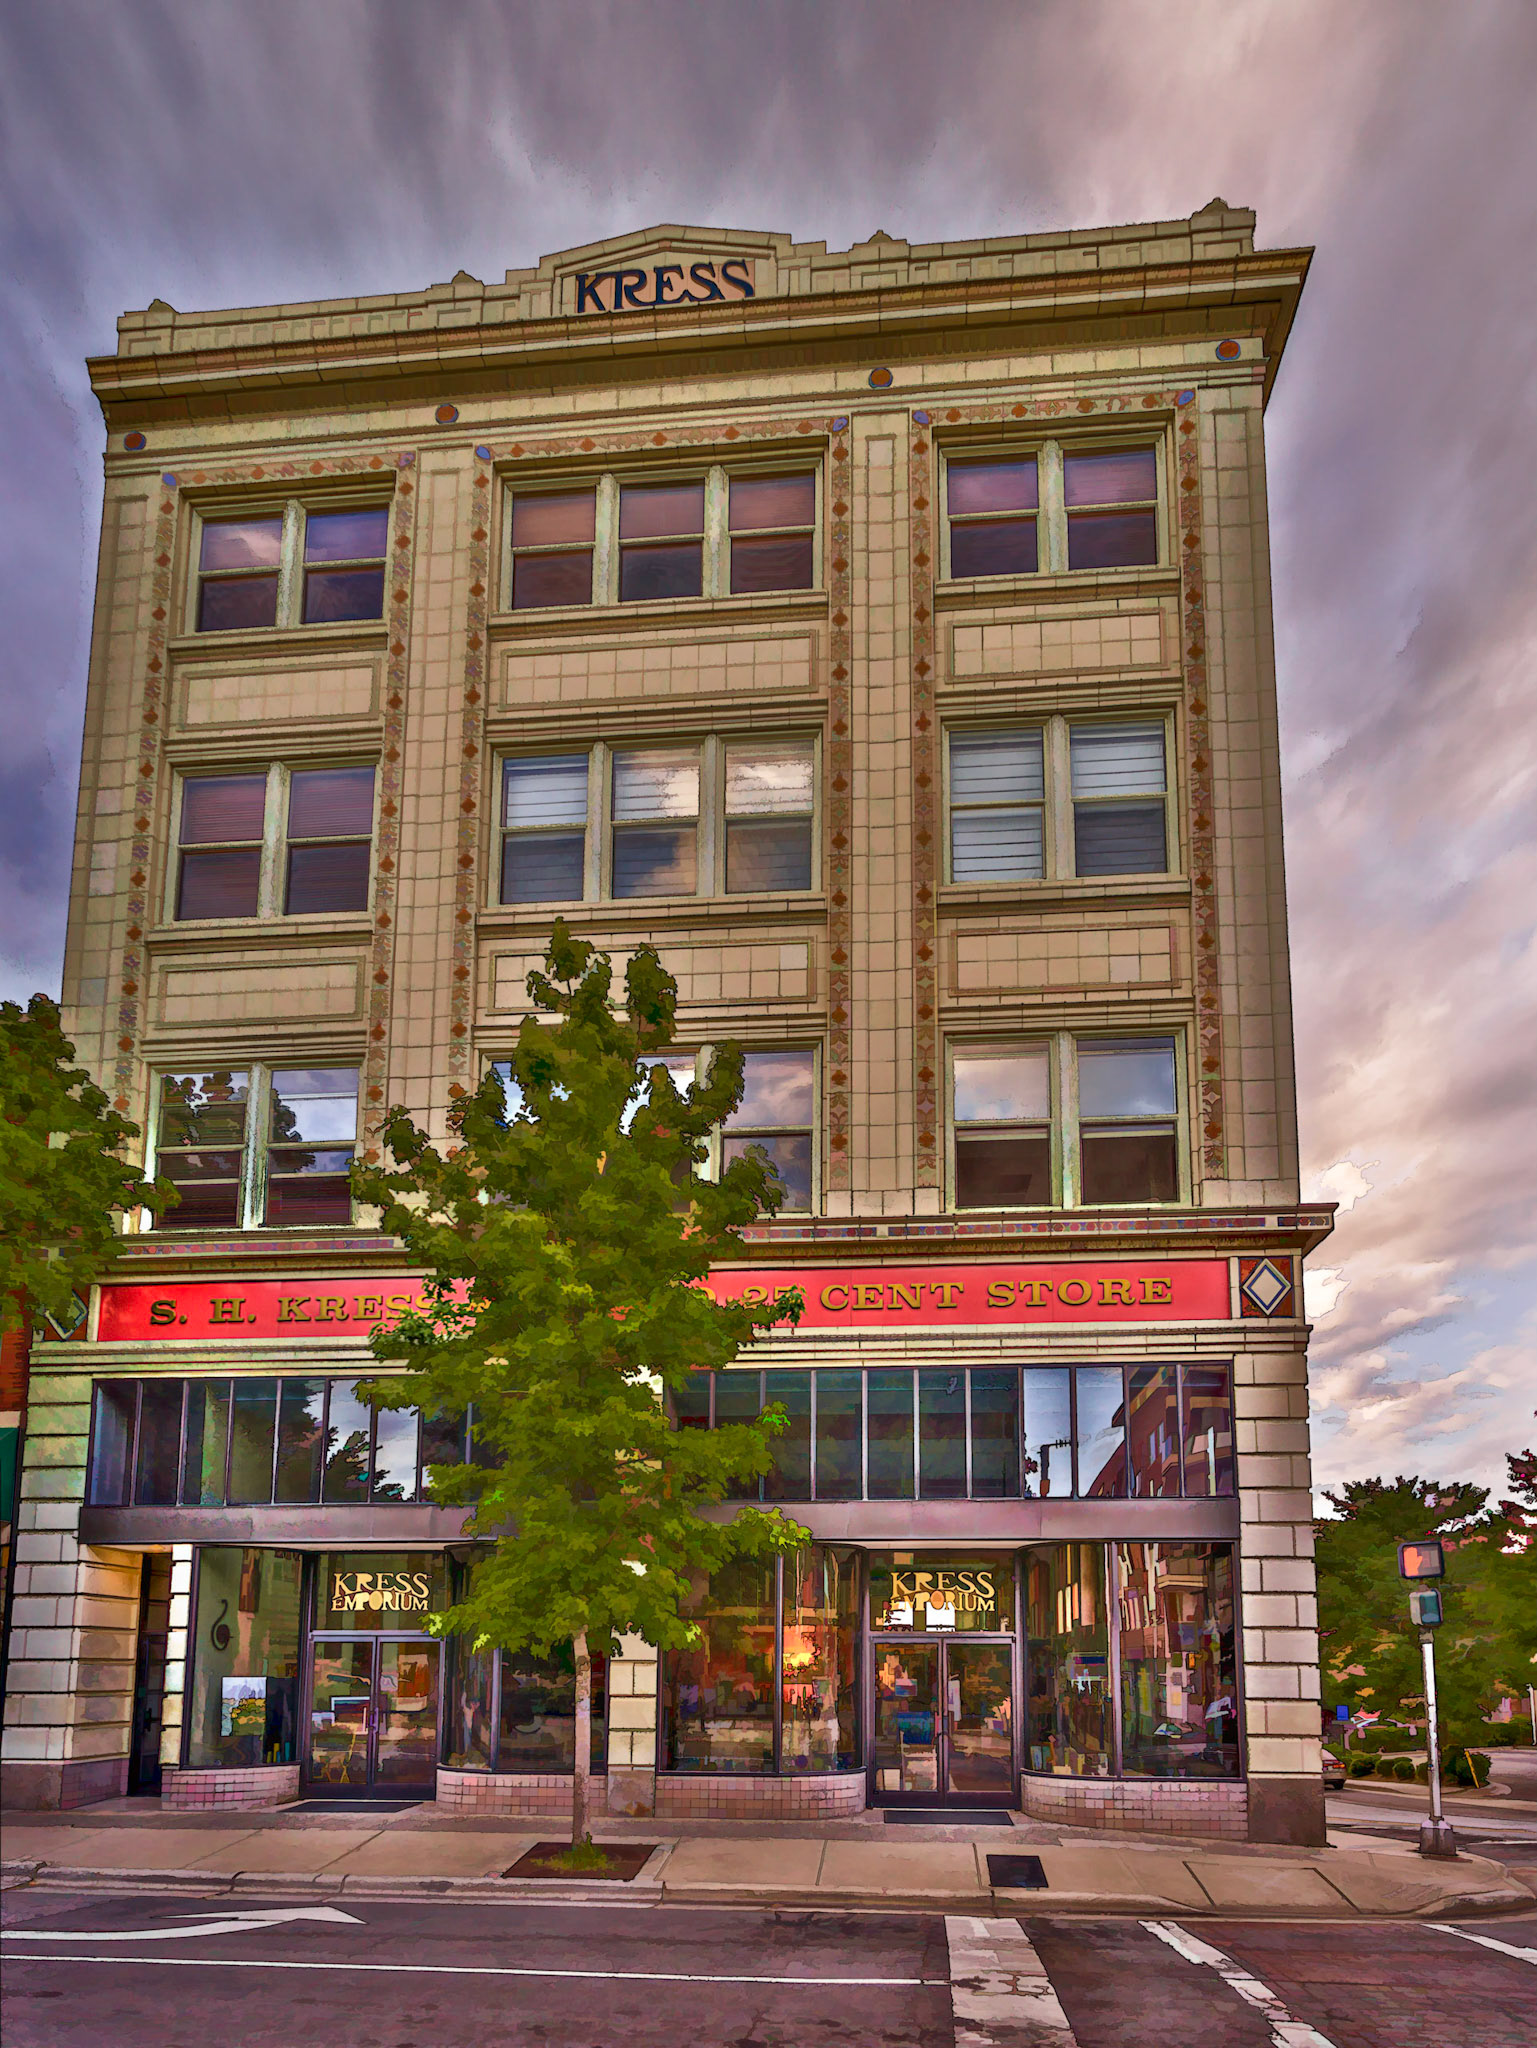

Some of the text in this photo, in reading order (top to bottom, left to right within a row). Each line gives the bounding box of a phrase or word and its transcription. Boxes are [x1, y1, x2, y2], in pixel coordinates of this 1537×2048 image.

[575, 259, 755, 313] KRESS
[150, 1299, 187, 1325] S.
[209, 1298, 256, 1323] H.
[277, 1294, 438, 1321] KRESS
[820, 1282, 965, 1310] CENT
[987, 1277, 1174, 1307] STORE
[332, 1572, 430, 1599] KRESS
[890, 1571, 996, 1599] KRESS
[331, 1591, 429, 1611] EMPORIUM
[890, 1590, 996, 1612] EMPORIUM
